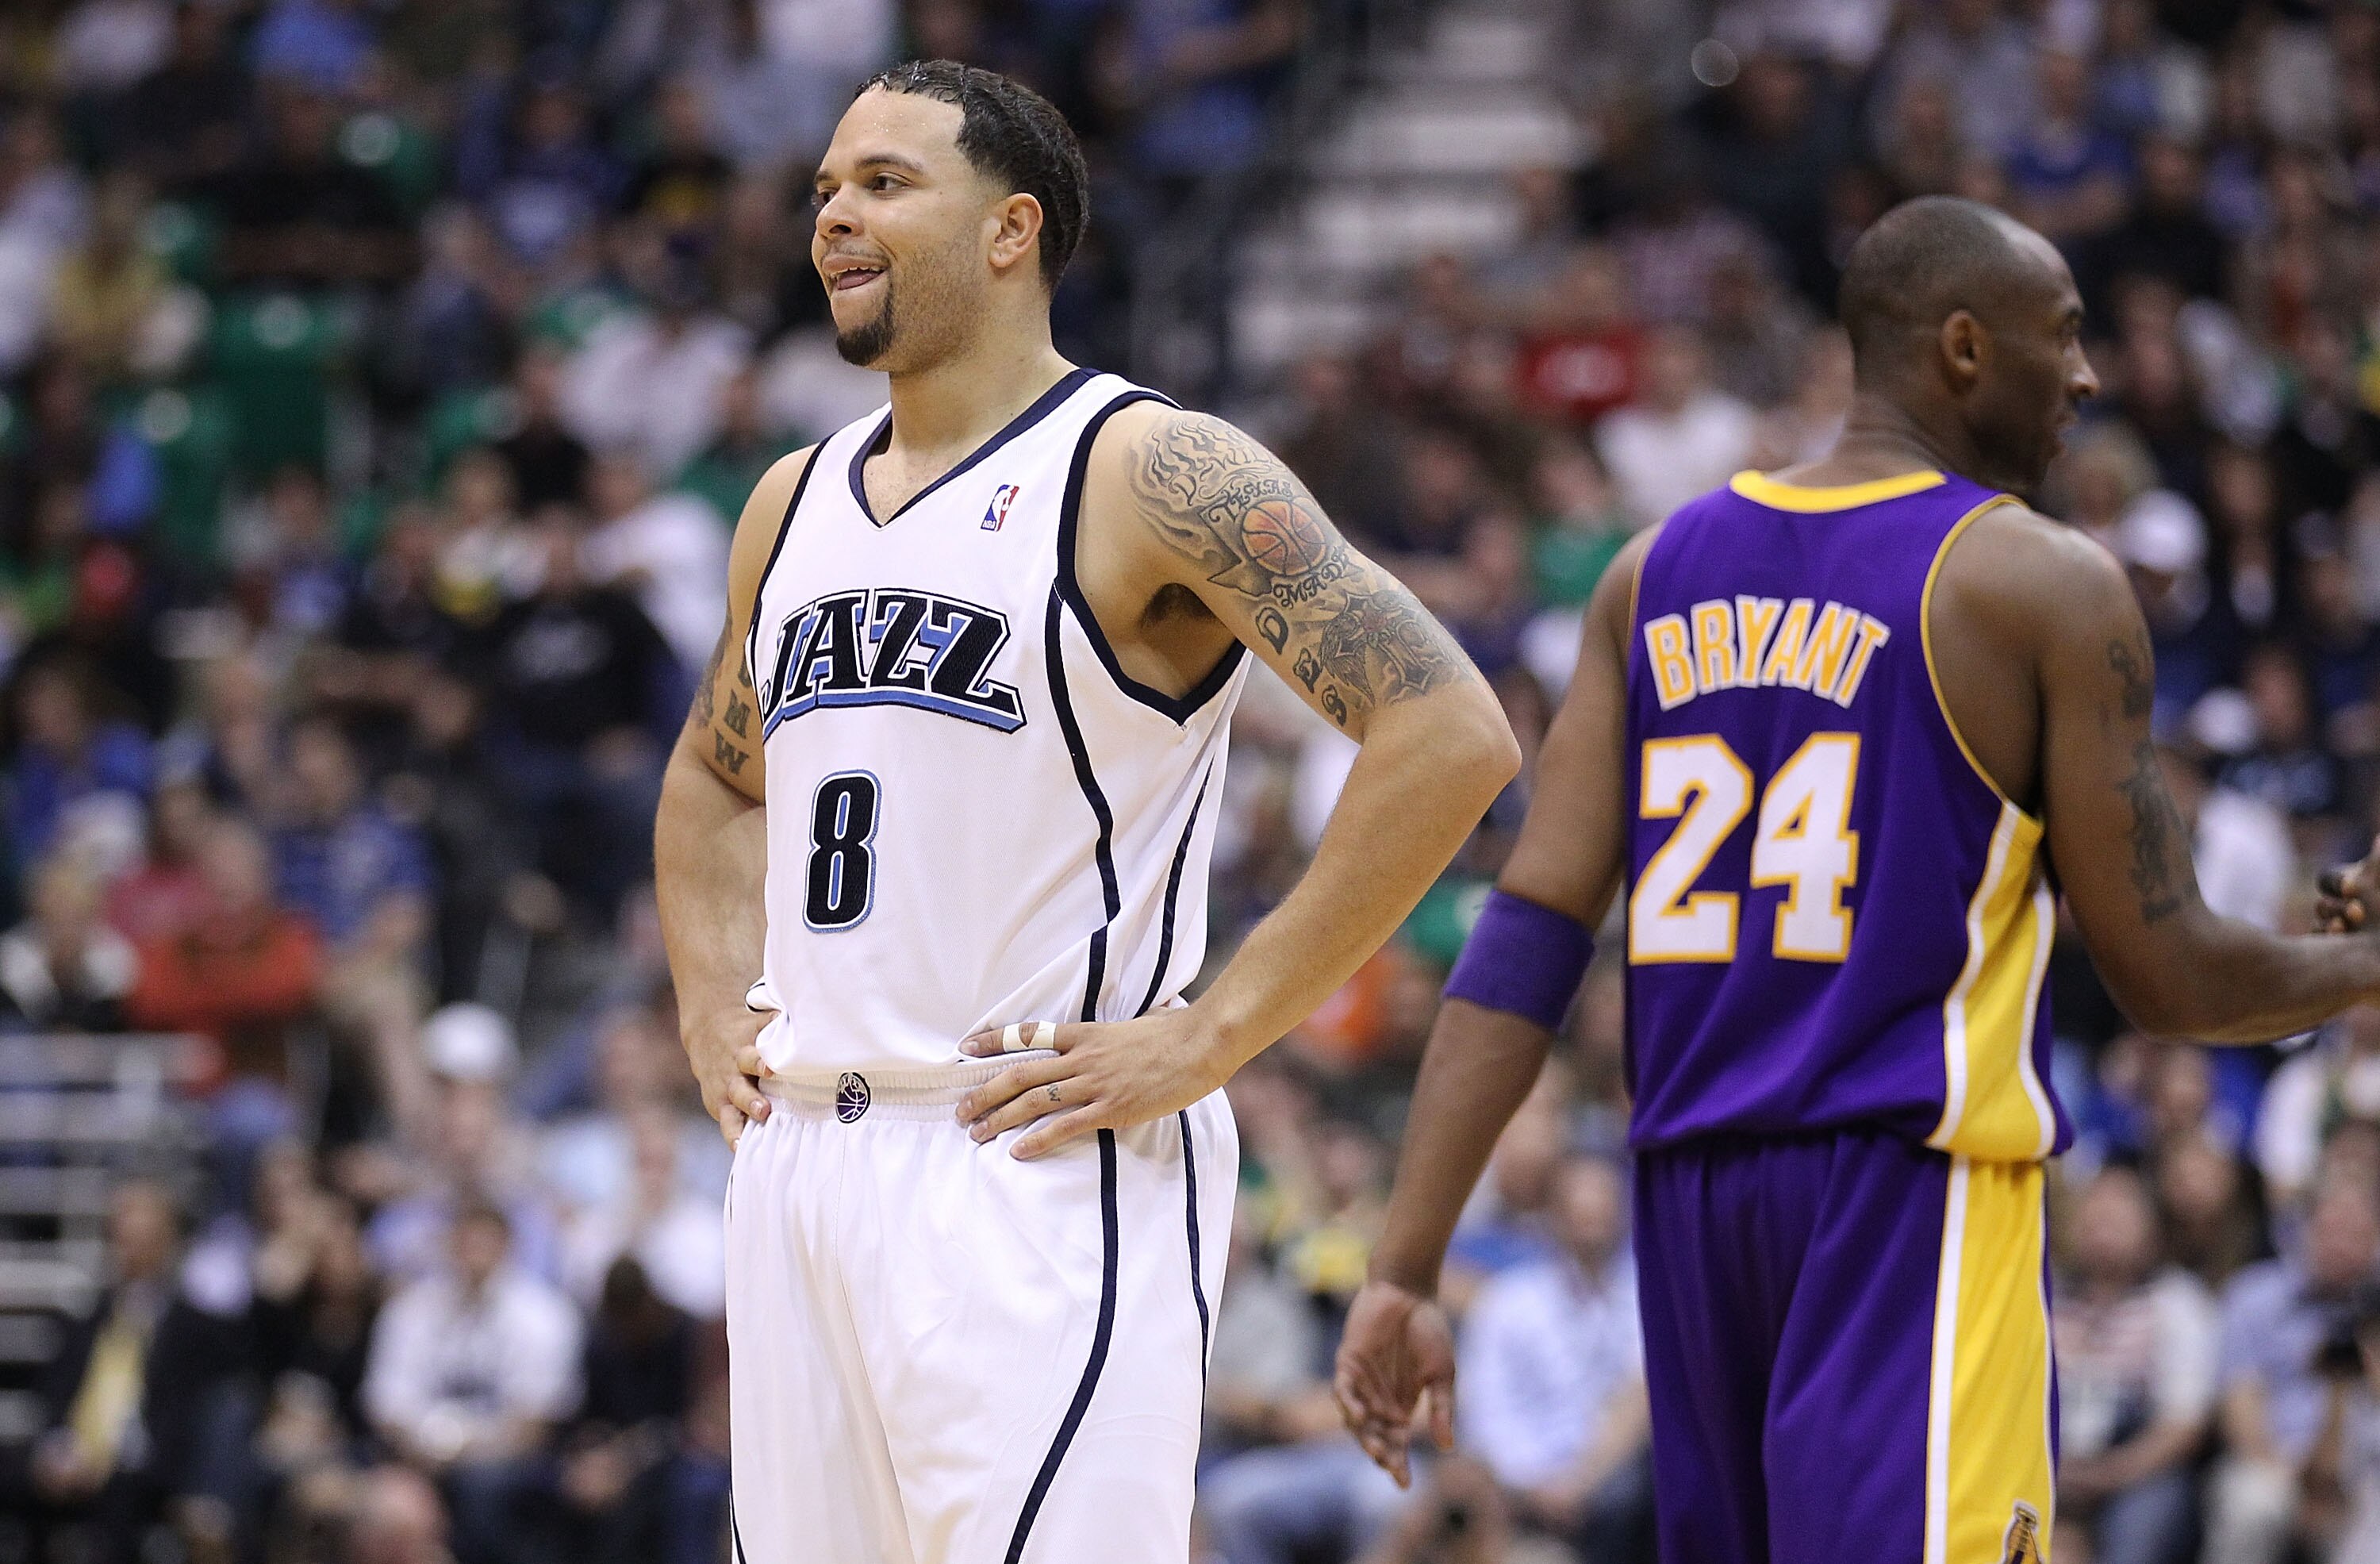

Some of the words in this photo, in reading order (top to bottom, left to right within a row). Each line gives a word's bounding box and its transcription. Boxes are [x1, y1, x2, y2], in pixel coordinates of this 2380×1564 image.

[1207, 478, 1293, 523] TEXAS
[760, 587, 1027, 741] JAZZ
[1644, 594, 1891, 712] BRYANT
[803, 769, 881, 933] 8
[1628, 730, 1862, 966] 24
